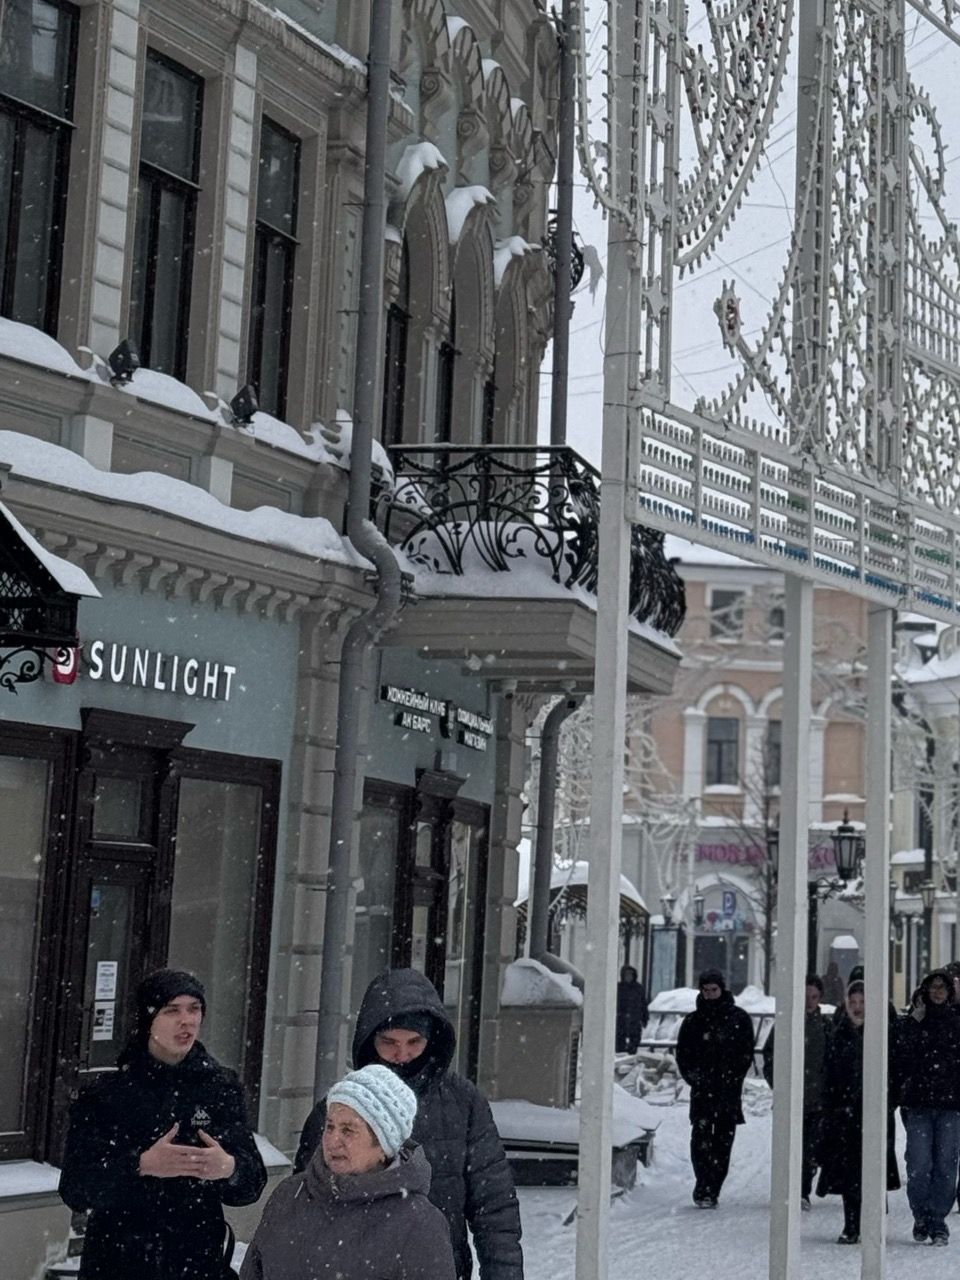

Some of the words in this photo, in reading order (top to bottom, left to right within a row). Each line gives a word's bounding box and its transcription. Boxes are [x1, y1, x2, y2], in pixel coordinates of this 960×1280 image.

[88, 640, 237, 701] SUNLIGHT
[386, 685, 430, 711] ХОККЕЙНЫЙ
[429, 698, 446, 717] КЛУБ
[401, 711, 412, 728] АК
[411, 715, 432, 733] БАРС
